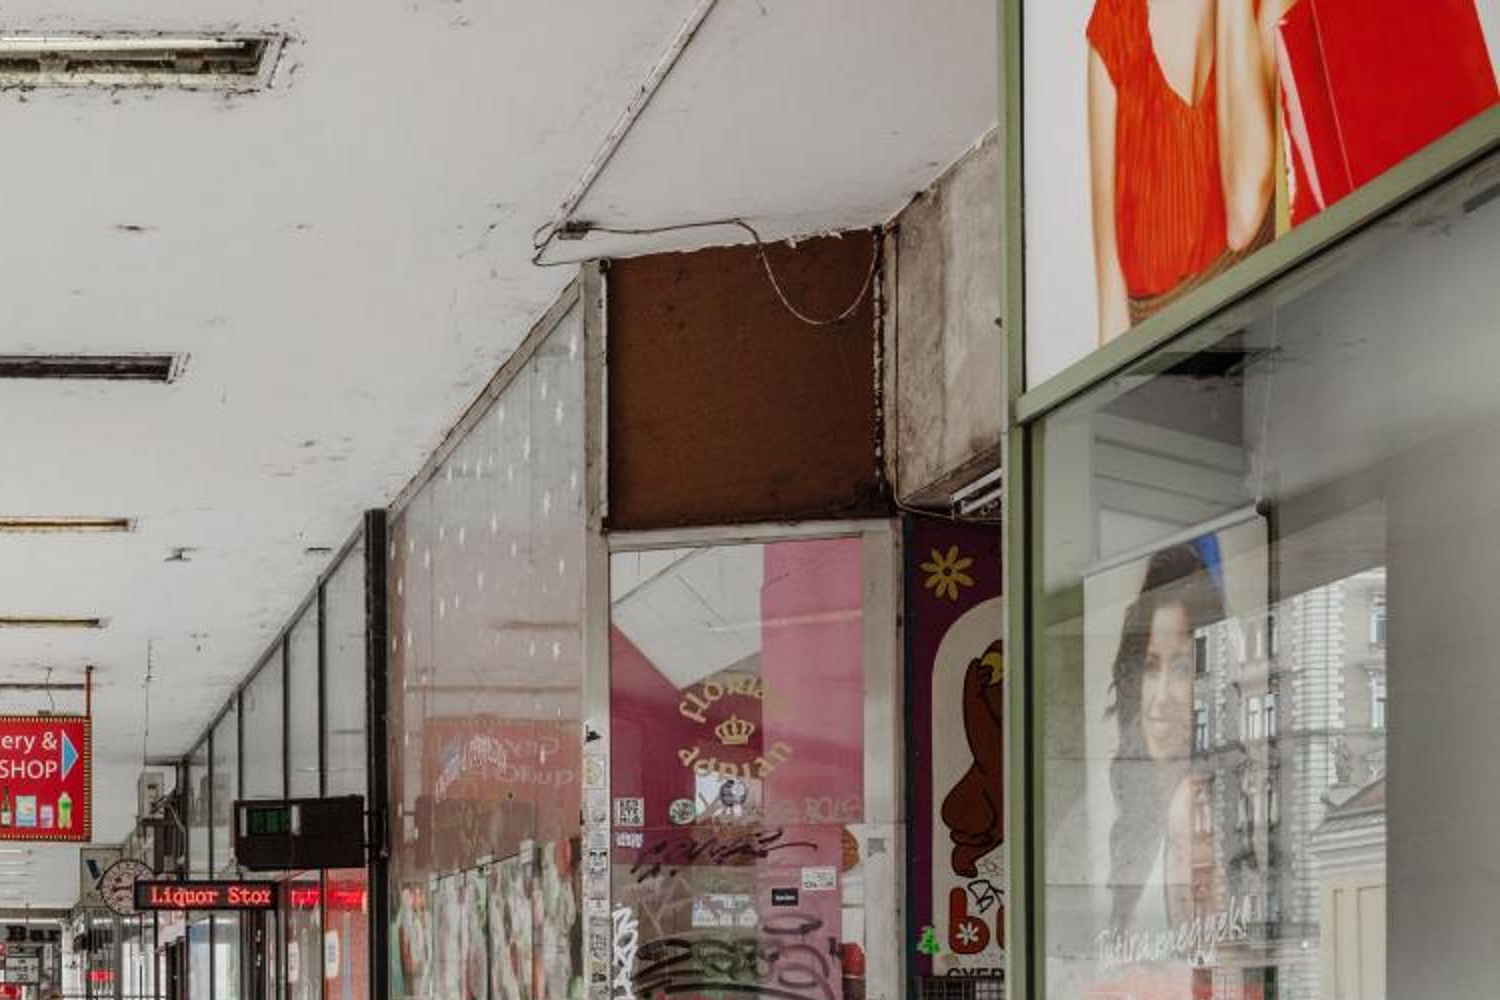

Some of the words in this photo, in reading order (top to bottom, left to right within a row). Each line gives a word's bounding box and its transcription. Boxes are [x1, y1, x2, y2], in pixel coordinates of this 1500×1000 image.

[41, 731, 58, 750] &
[150, 886, 219, 907] Liquor
[5, 924, 62, 942] Bar
